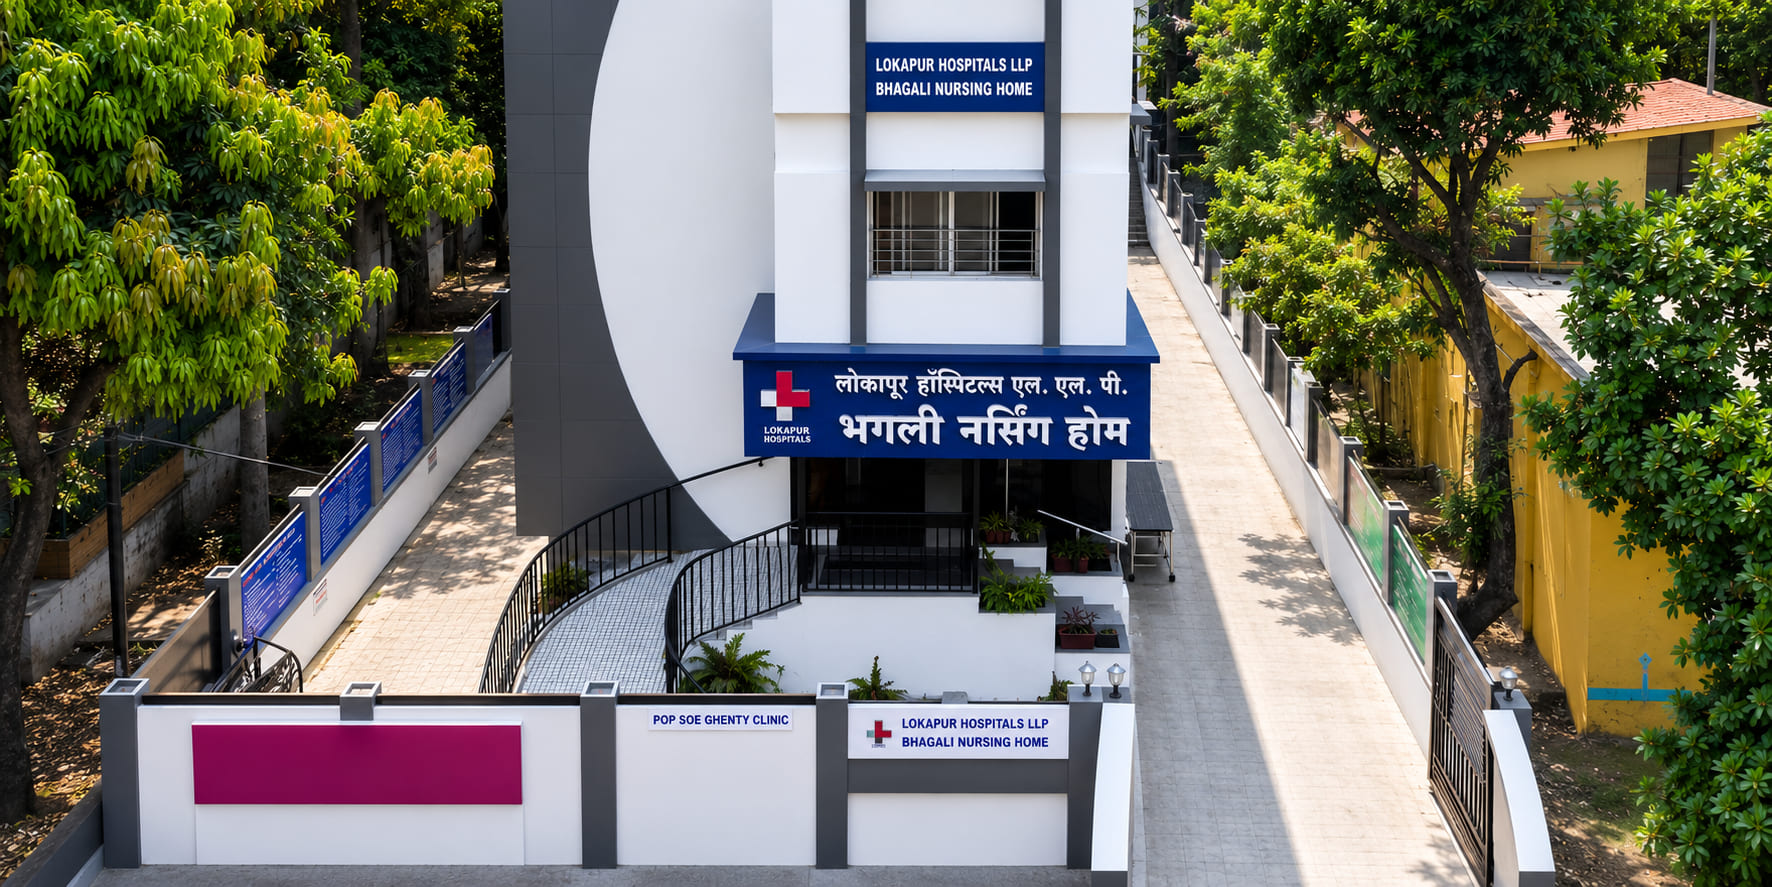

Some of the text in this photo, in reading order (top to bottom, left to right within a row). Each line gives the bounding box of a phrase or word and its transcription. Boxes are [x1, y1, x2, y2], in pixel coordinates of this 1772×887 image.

[876, 58, 1033, 72] LOKAPUR HOSPITALS LLP
[876, 82, 1033, 96] BHAGALI NURSING HOME
[834, 367, 1128, 400] लोकापूर हॉस्पिटल्स एल. एल. पी.
[763, 426, 810, 435] LOKAPUR
[838, 403, 1131, 451] भगली नर्सिंग होम
[763, 435, 812, 443] HOSPITALS
[653, 714, 789, 725] POP SOE GHENTY CLINIC
[902, 718, 1049, 729] LOKAPUR HOSPITALS LLP
[902, 736, 1049, 748] BHAGALI NURSING HOME
